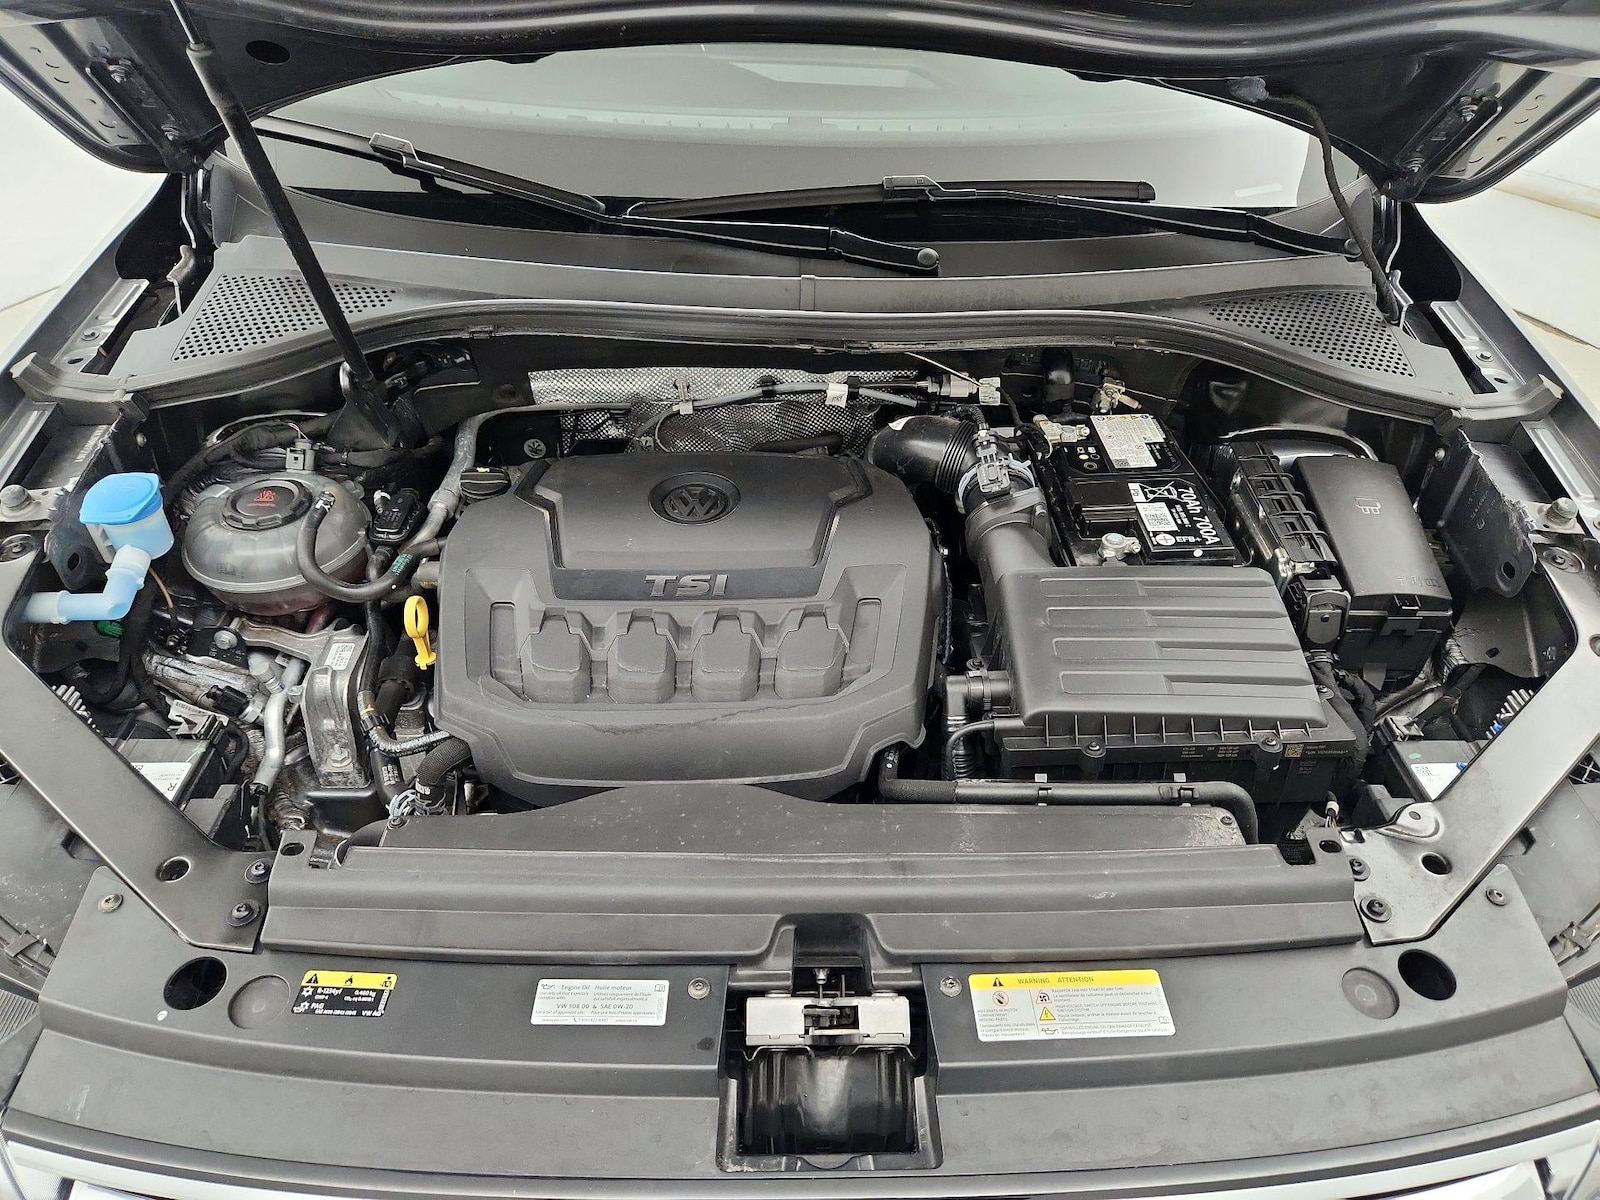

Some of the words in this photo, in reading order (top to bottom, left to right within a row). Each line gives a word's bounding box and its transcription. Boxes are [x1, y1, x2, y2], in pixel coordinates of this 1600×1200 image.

[1178, 487, 1203, 514] 70Ah
[1193, 515, 1220, 545] 700A
[645, 574, 729, 597] TSI
[1018, 977, 1050, 985] WARNING
